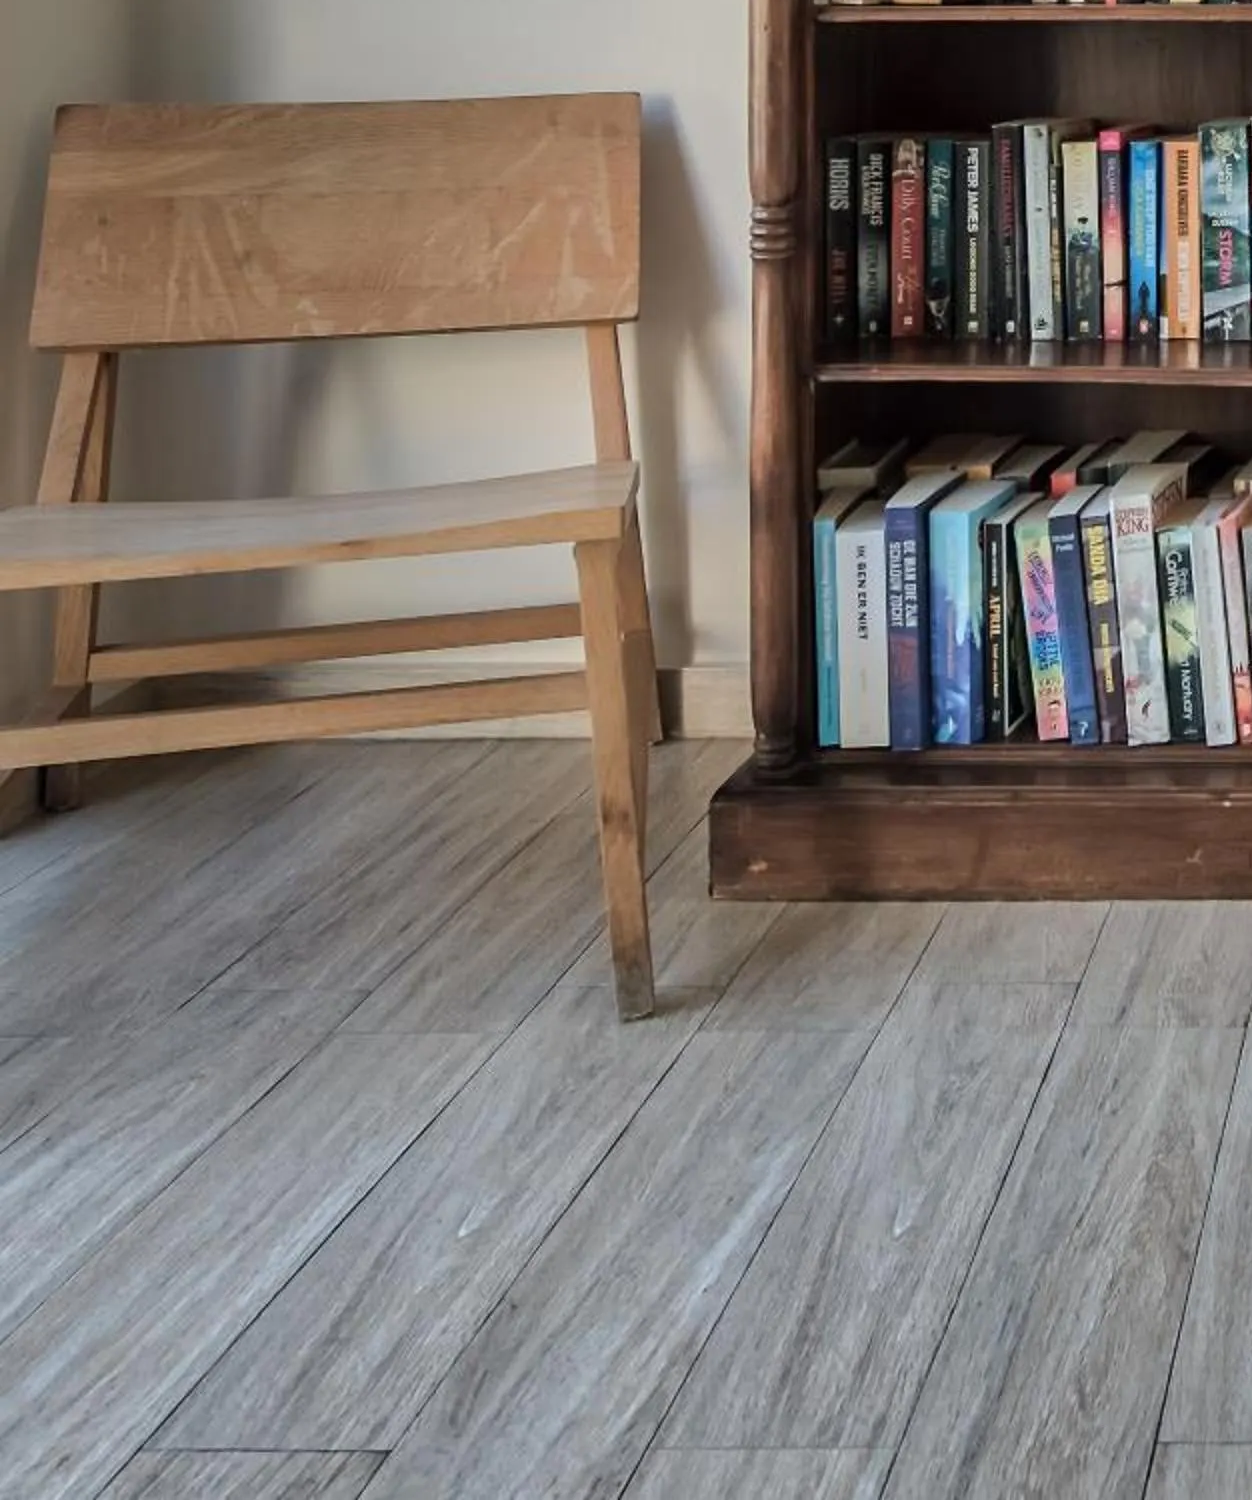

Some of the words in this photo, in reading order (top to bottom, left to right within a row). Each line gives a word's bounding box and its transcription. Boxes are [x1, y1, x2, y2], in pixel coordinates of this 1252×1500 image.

[869, 153, 884, 178] DICK
[967, 146, 979, 187] PETER
[1178, 149, 1189, 186] BARBARA
[829, 158, 850, 211] HORNS
[898, 179, 917, 211] Dilly
[869, 181, 884, 226] FRANCIS
[967, 189, 979, 232] JAMES
[901, 217, 914, 260] Court
[1219, 230, 1233, 285] STORM
[1116, 518, 1149, 537] KING
[856, 545, 867, 558] IK
[890, 542, 903, 591] SCHADUW
[1088, 526, 1107, 576] SANDA
[857, 562, 868, 589] BEN
[904, 557, 917, 581] MAN
[857, 591, 867, 609] ER
[904, 584, 917, 601] DIE
[1093, 579, 1109, 605] DIA
[857, 611, 869, 640] NIET
[890, 595, 904, 627] ZOCHT
[989, 594, 1001, 640] APRIL
[1181, 669, 1194, 721] Mortuary
